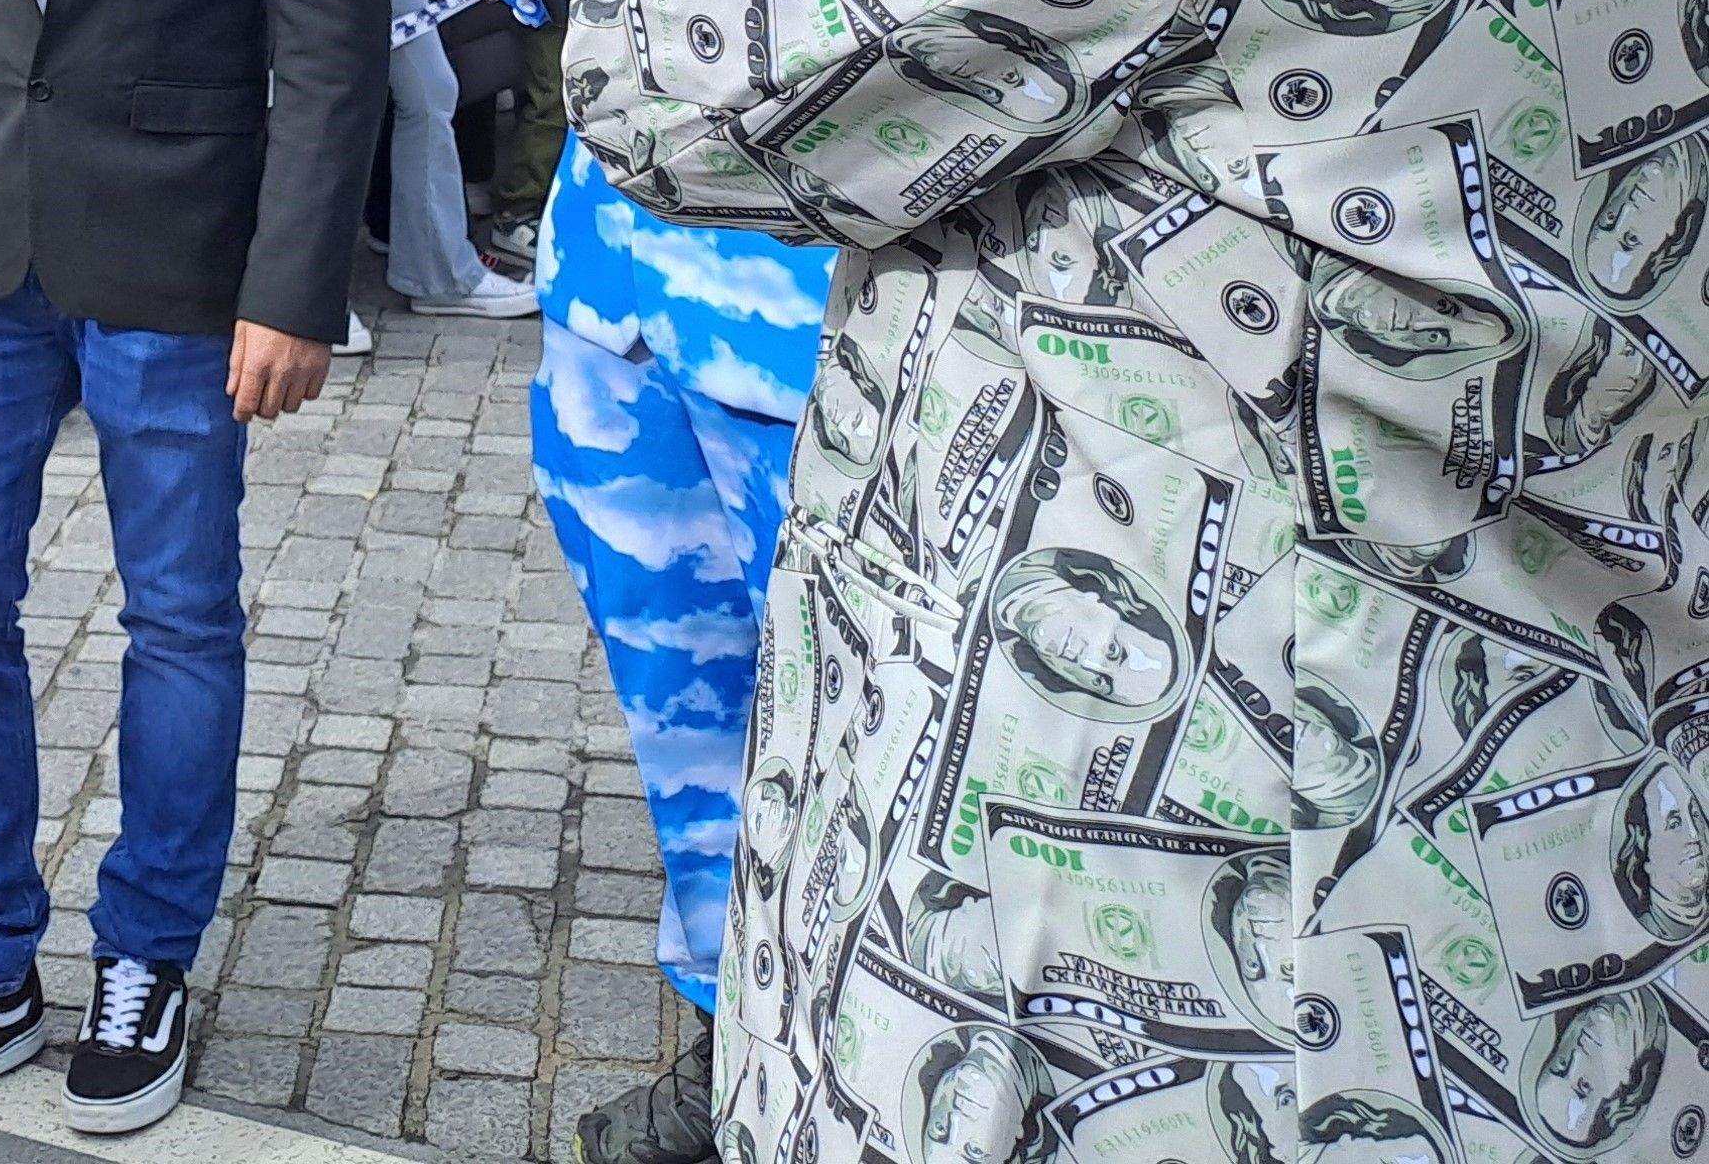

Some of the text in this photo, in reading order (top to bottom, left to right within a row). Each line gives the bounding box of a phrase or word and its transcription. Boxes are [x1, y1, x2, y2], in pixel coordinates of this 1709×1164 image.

[791, 119, 840, 154] 100
[1596, 103, 1677, 155] 100
[1454, 138, 1494, 261] 100
[1033, 310, 1110, 334] DOLLARS
[1036, 333, 1112, 365] 100
[951, 453, 1008, 555] 100
[1330, 445, 1368, 524] 100
[1191, 495, 1226, 617] 100
[1586, 521, 1660, 551] 100
[1473, 609, 1560, 647] HUNDRED
[891, 719, 942, 822] 100
[1177, 757, 1246, 802] 9560FE
[950, 775, 988, 857] 100
[1199, 789, 1284, 836] 100
[1493, 775, 1596, 820] 100
[1009, 834, 1085, 872] 100
[1541, 952, 1626, 993] 100
[1025, 995, 1147, 1036] 100
[1387, 950, 1432, 1080] 100
[1071, 1067, 1176, 1115] 100
